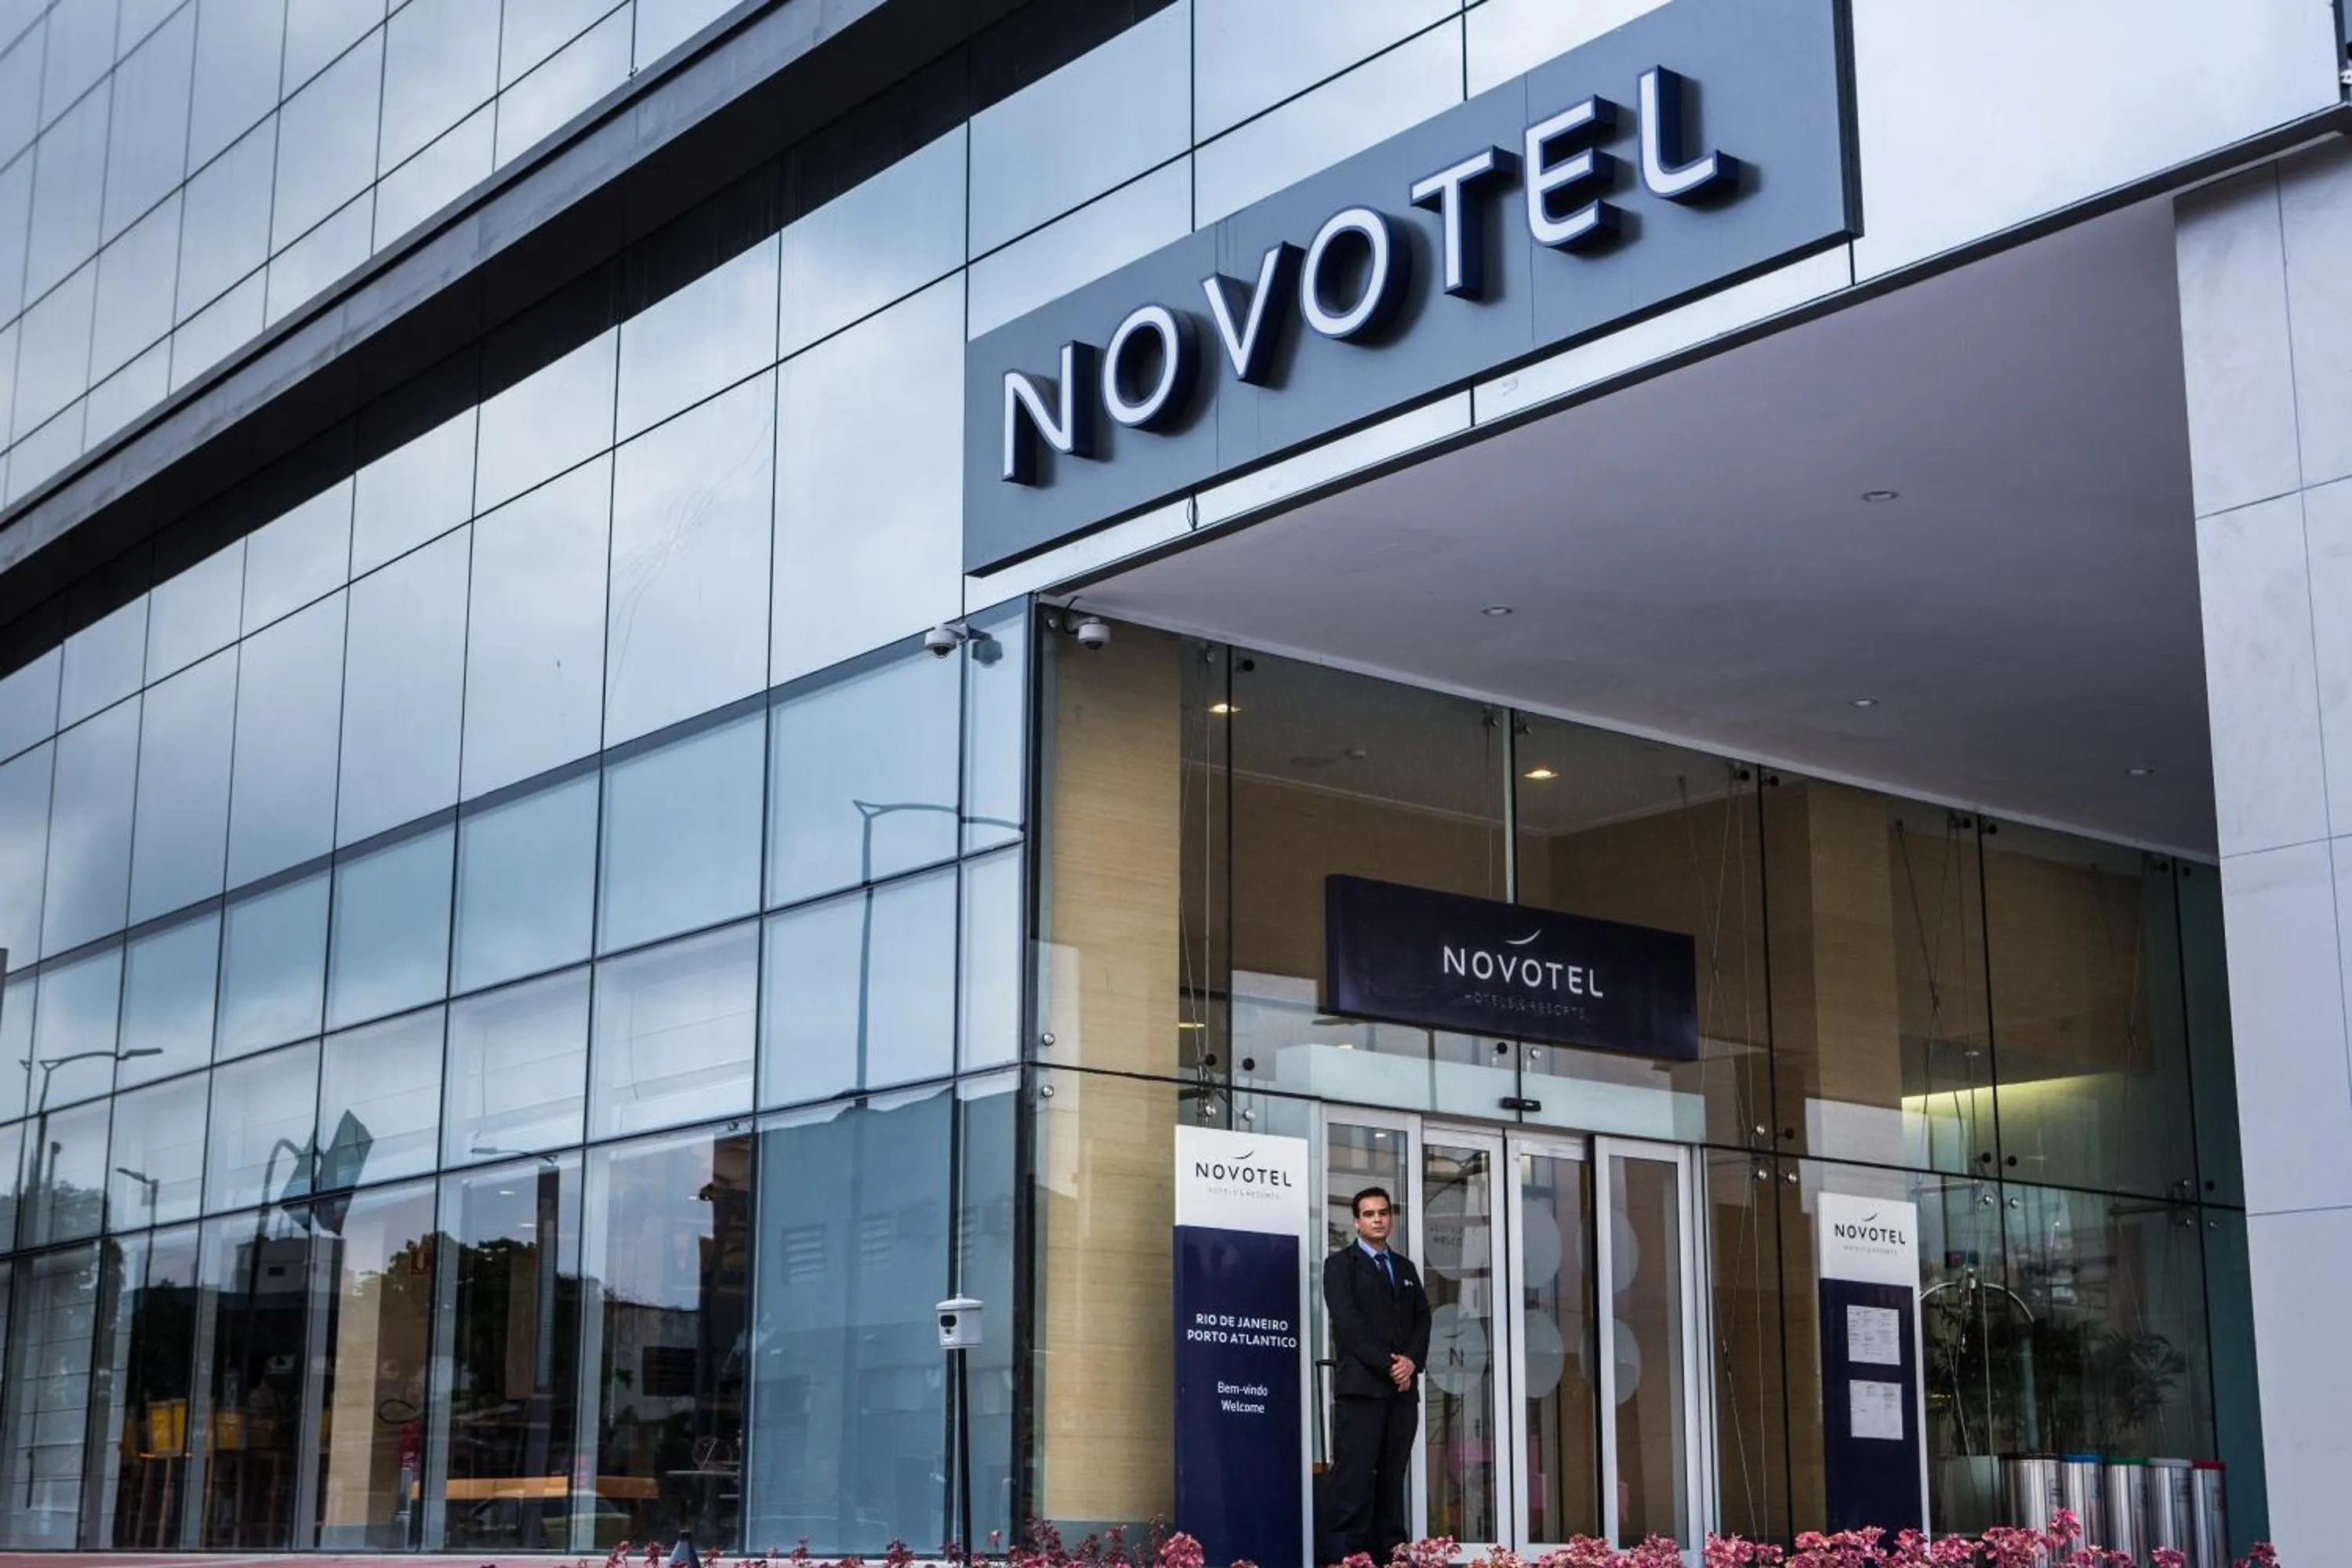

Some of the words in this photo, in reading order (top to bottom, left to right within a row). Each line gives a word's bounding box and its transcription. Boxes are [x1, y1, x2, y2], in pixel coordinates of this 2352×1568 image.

[1002, 64, 1738, 484] NOVOTEL
[1443, 946, 1603, 997] NOVOTEL
[1196, 1162, 1292, 1188] NOVOTEL
[1835, 1223, 1906, 1244] NOVOTEL
[1196, 1313, 1217, 1327] RIO
[1220, 1316, 1235, 1327] DE
[1237, 1317, 1288, 1331] JANEIRO
[1187, 1330, 1227, 1343] PORTO
[1230, 1334, 1297, 1348] ATLANTICO
[1218, 1381, 1268, 1396] Bem-vindo
[1221, 1400, 1265, 1414] Welcome
